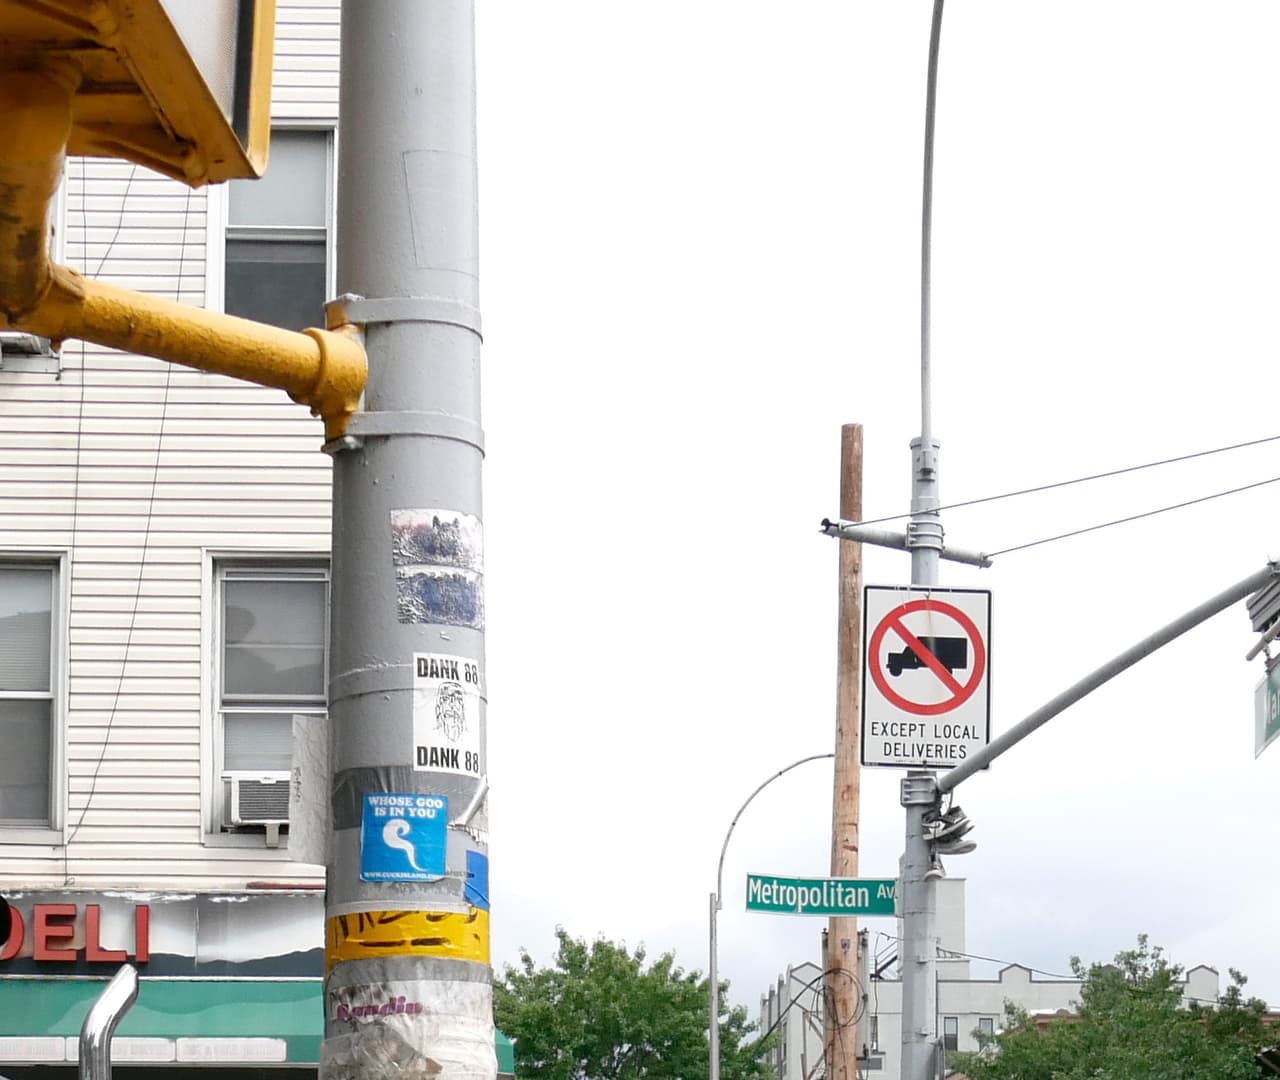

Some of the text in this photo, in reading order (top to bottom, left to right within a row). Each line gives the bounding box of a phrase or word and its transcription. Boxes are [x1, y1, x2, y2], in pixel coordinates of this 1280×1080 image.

[416, 657, 479, 685] DANK 88
[871, 721, 980, 740] EXCEPT LOCAL
[416, 746, 479, 773] DANK 88
[883, 742, 967, 760] DELIVERIES
[368, 796, 443, 809] WHOSE GOO
[375, 806, 436, 819] IS IN YOU
[748, 878, 869, 913] Metropolitan
